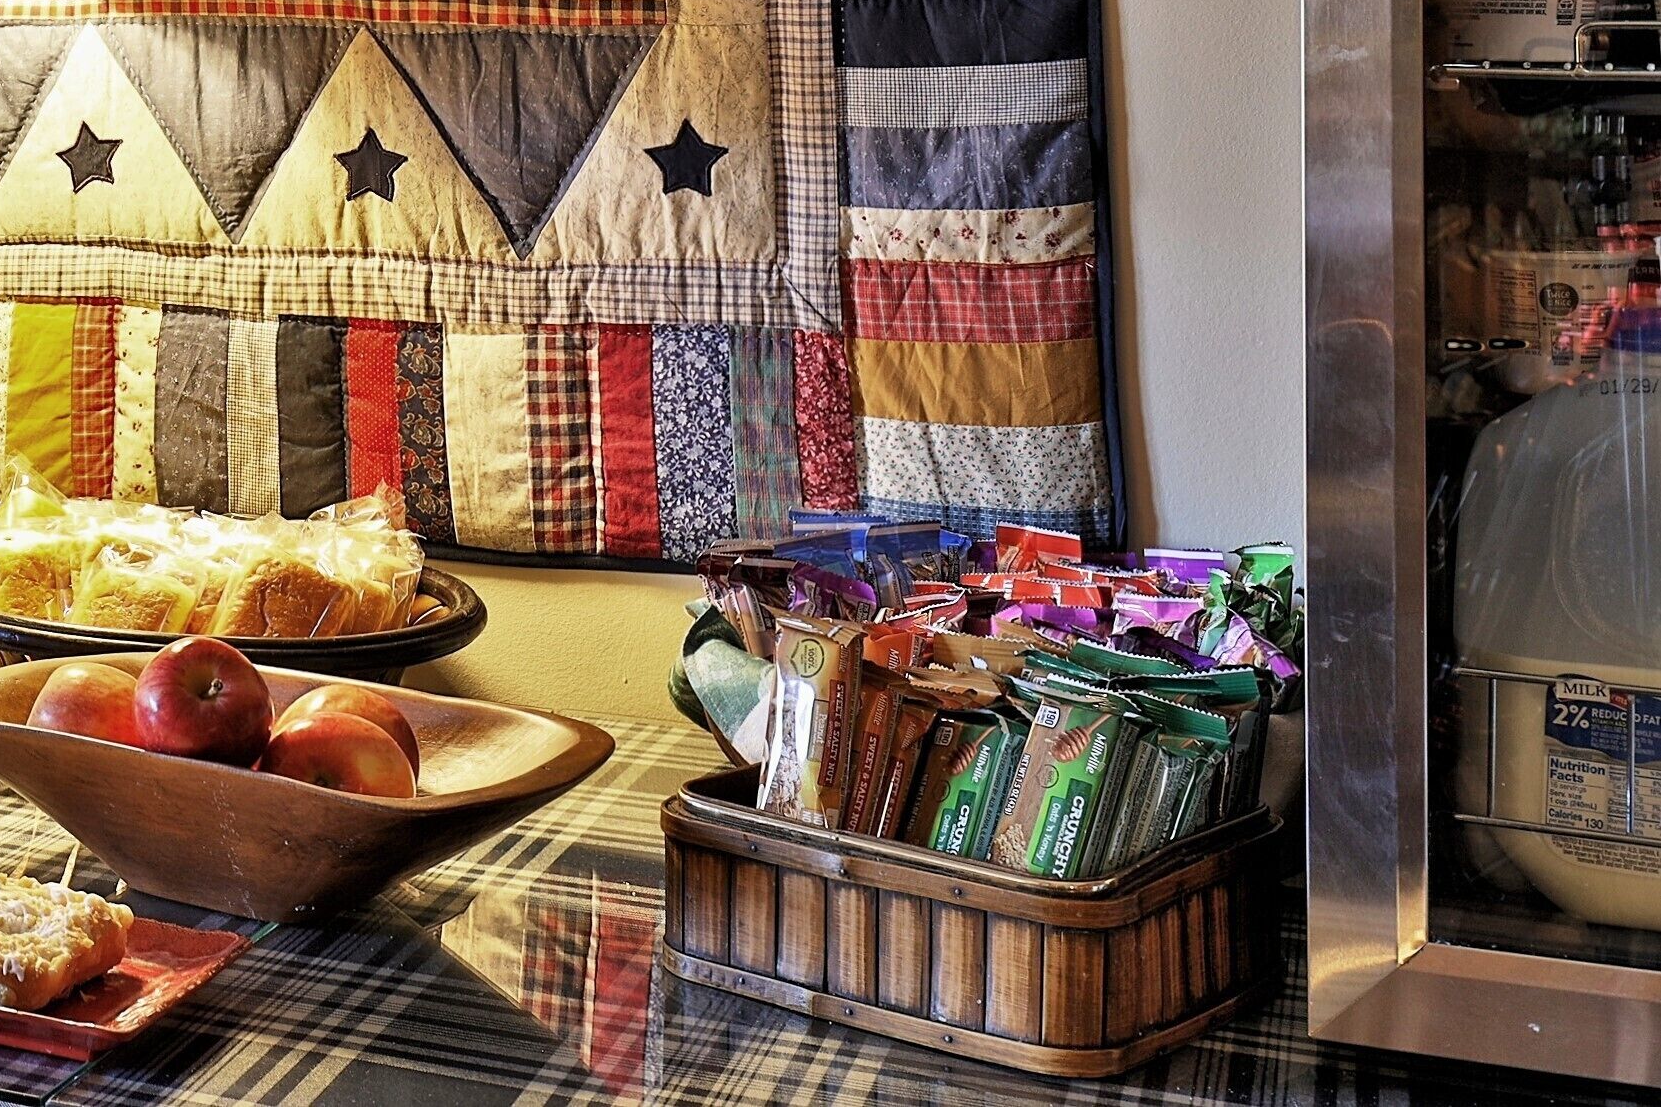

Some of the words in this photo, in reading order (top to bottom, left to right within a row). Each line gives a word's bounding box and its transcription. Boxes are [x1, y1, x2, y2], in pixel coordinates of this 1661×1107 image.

[808, 647, 818, 669] 100%
[839, 645, 850, 673] illville
[1564, 682, 1607, 697] MILK
[834, 683, 845, 718] SWEET
[873, 693, 888, 725] Millville
[1045, 710, 1057, 725] 190
[1552, 703, 1590, 729] 2%
[1591, 708, 1641, 723] REDUCD
[817, 713, 827, 744] Peanut
[942, 729, 950, 743] 190
[828, 729, 840, 761] SALTY
[864, 736, 876, 771] SWEET
[1086, 733, 1107, 774] Millville
[971, 744, 990, 783] Millville
[1022, 754, 1031, 766] NET
[1550, 758, 1606, 775] Nutrition
[825, 762, 836, 784] NUT
[891, 761, 903, 793] SWEET
[1018, 767, 1027, 777] WT
[1550, 769, 1584, 783] Facts
[1011, 789, 1020, 797] OZ
[1014, 779, 1023, 788] 1.5
[1550, 789, 1566, 798] Serv.
[1558, 783, 1587, 793] servings
[854, 781, 868, 813] SALTY
[1004, 797, 1018, 815] (42g)
[1570, 800, 1597, 811] (240mL)
[802, 810, 811, 823] NO
[814, 812, 823, 826] NO
[1050, 802, 1061, 822] Oats
[1549, 808, 1582, 822] Calories
[1584, 818, 1604, 829] 130
[942, 814, 951, 833] Oats
[1051, 795, 1085, 879] CRUNCHY
[1036, 834, 1051, 861] Honey
